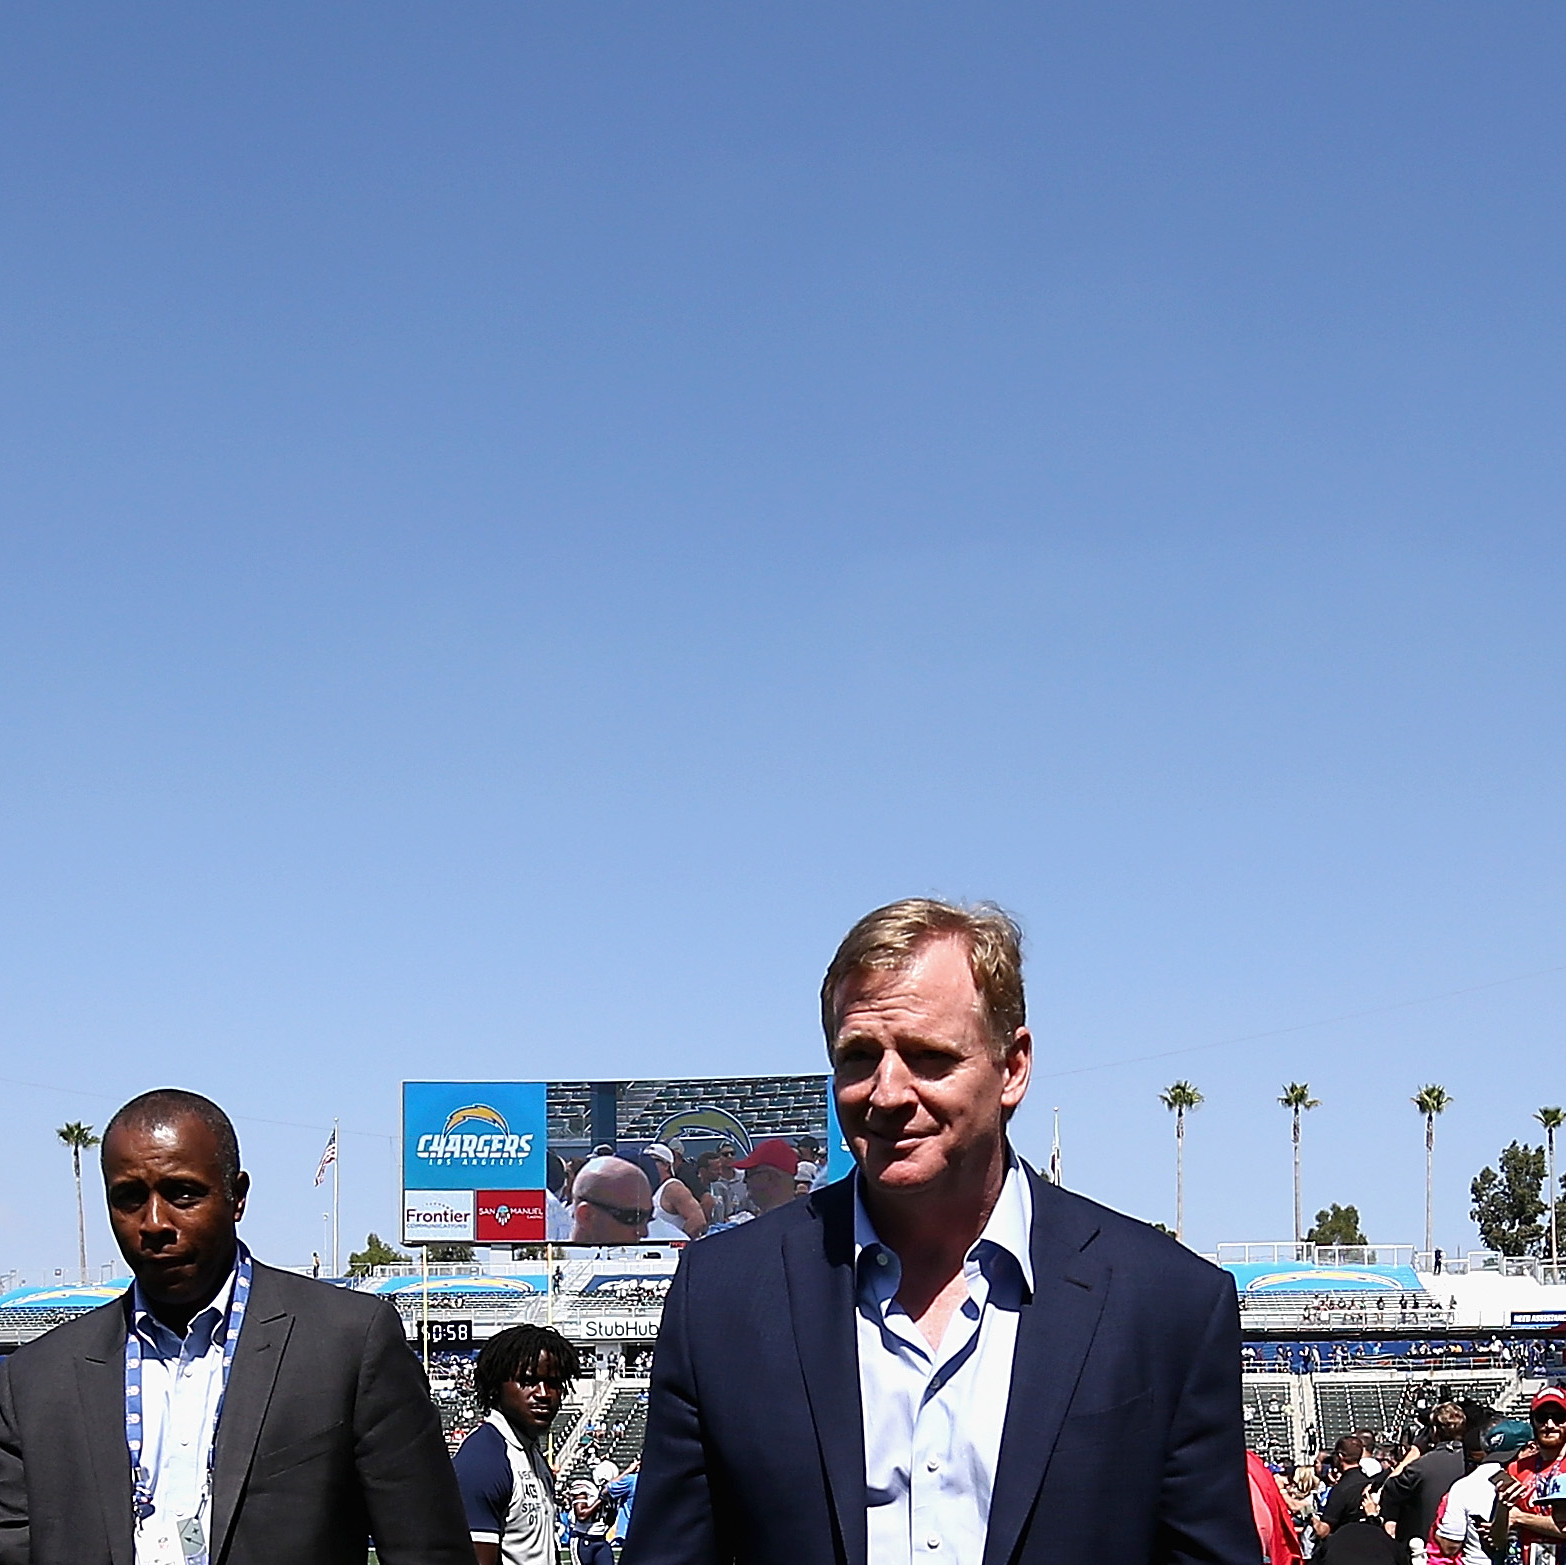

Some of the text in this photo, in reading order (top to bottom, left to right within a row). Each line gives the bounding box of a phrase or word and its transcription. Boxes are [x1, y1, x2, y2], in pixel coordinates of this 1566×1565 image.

[416, 1133, 534, 1158] CHARGERS
[406, 1208, 471, 1222] Frontier
[478, 1208, 495, 1216] SAN
[585, 1321, 659, 1337] StubHub
